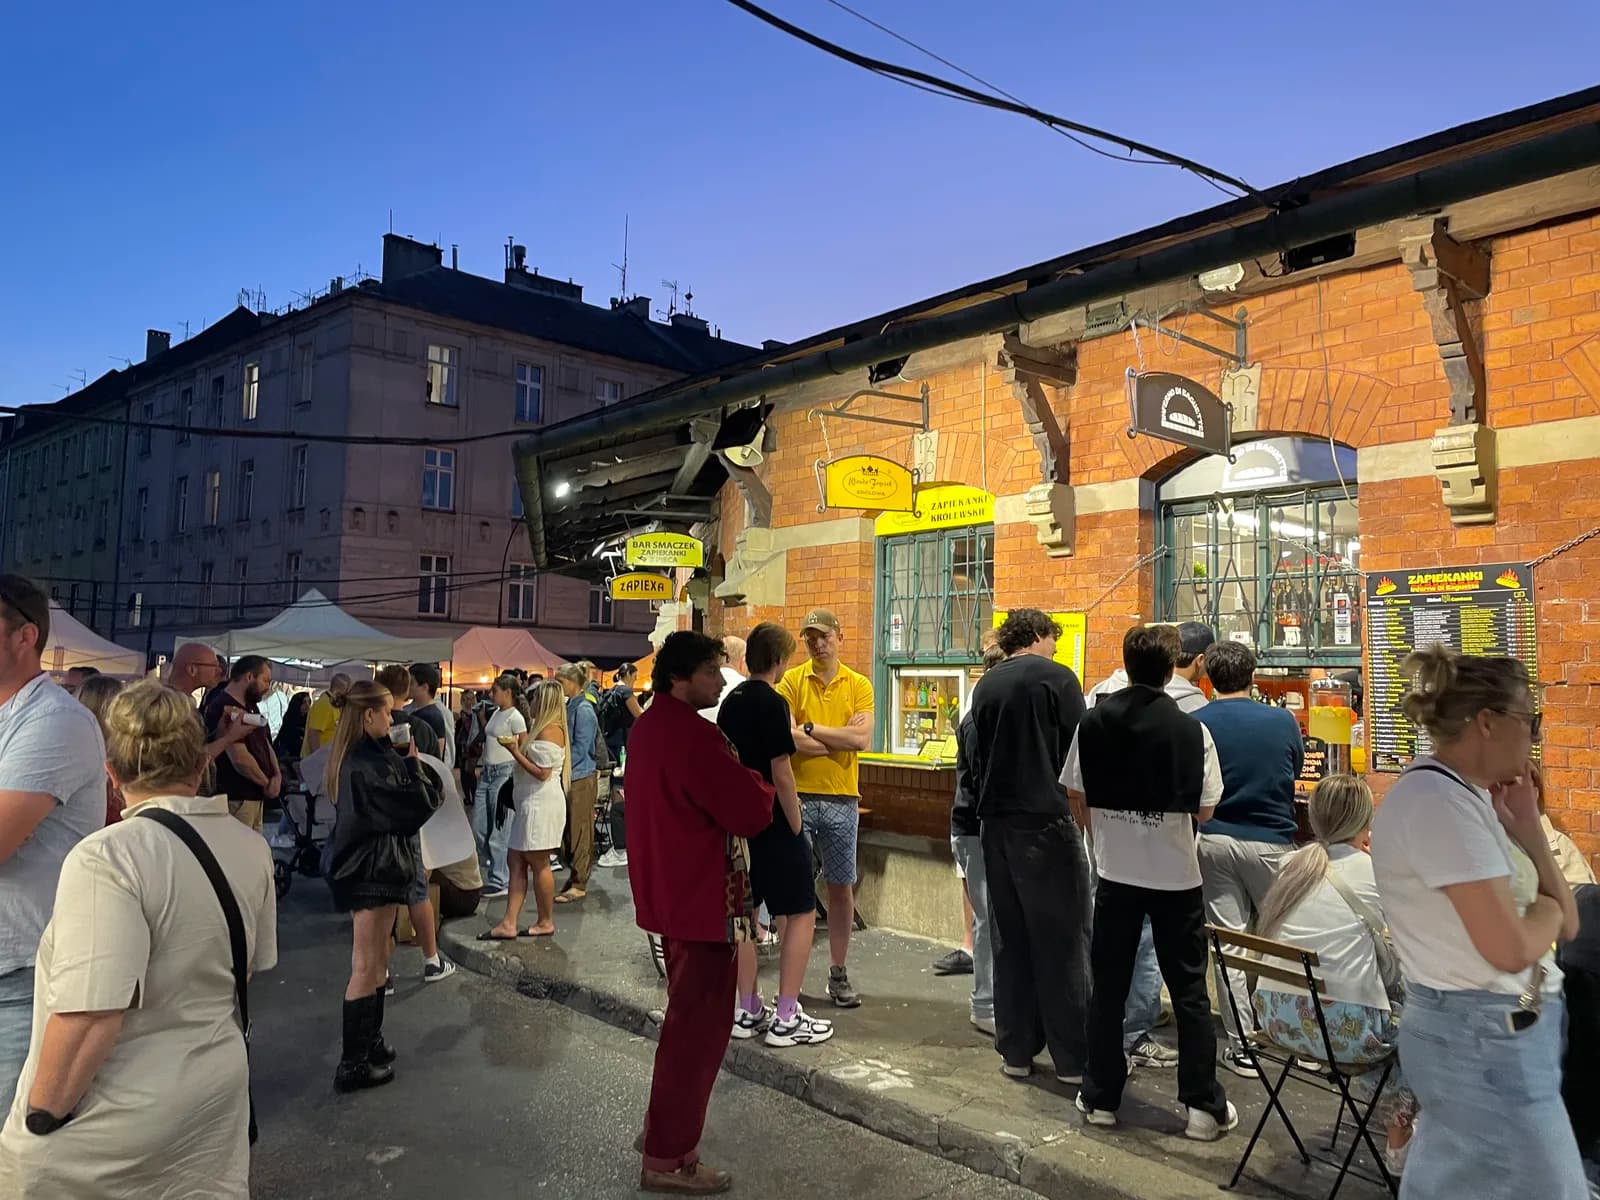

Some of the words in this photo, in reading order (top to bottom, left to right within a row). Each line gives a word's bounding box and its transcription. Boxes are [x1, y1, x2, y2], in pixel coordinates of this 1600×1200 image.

[931, 495, 988, 511] ZAPIEKANKI
[632, 541, 651, 549] BAR
[652, 541, 696, 550] SMACZEK
[641, 549, 687, 557] ZAPIEKANKI
[1407, 571, 1484, 585] ZAPIEKANKI
[620, 579, 665, 592] ZAPIEXA
